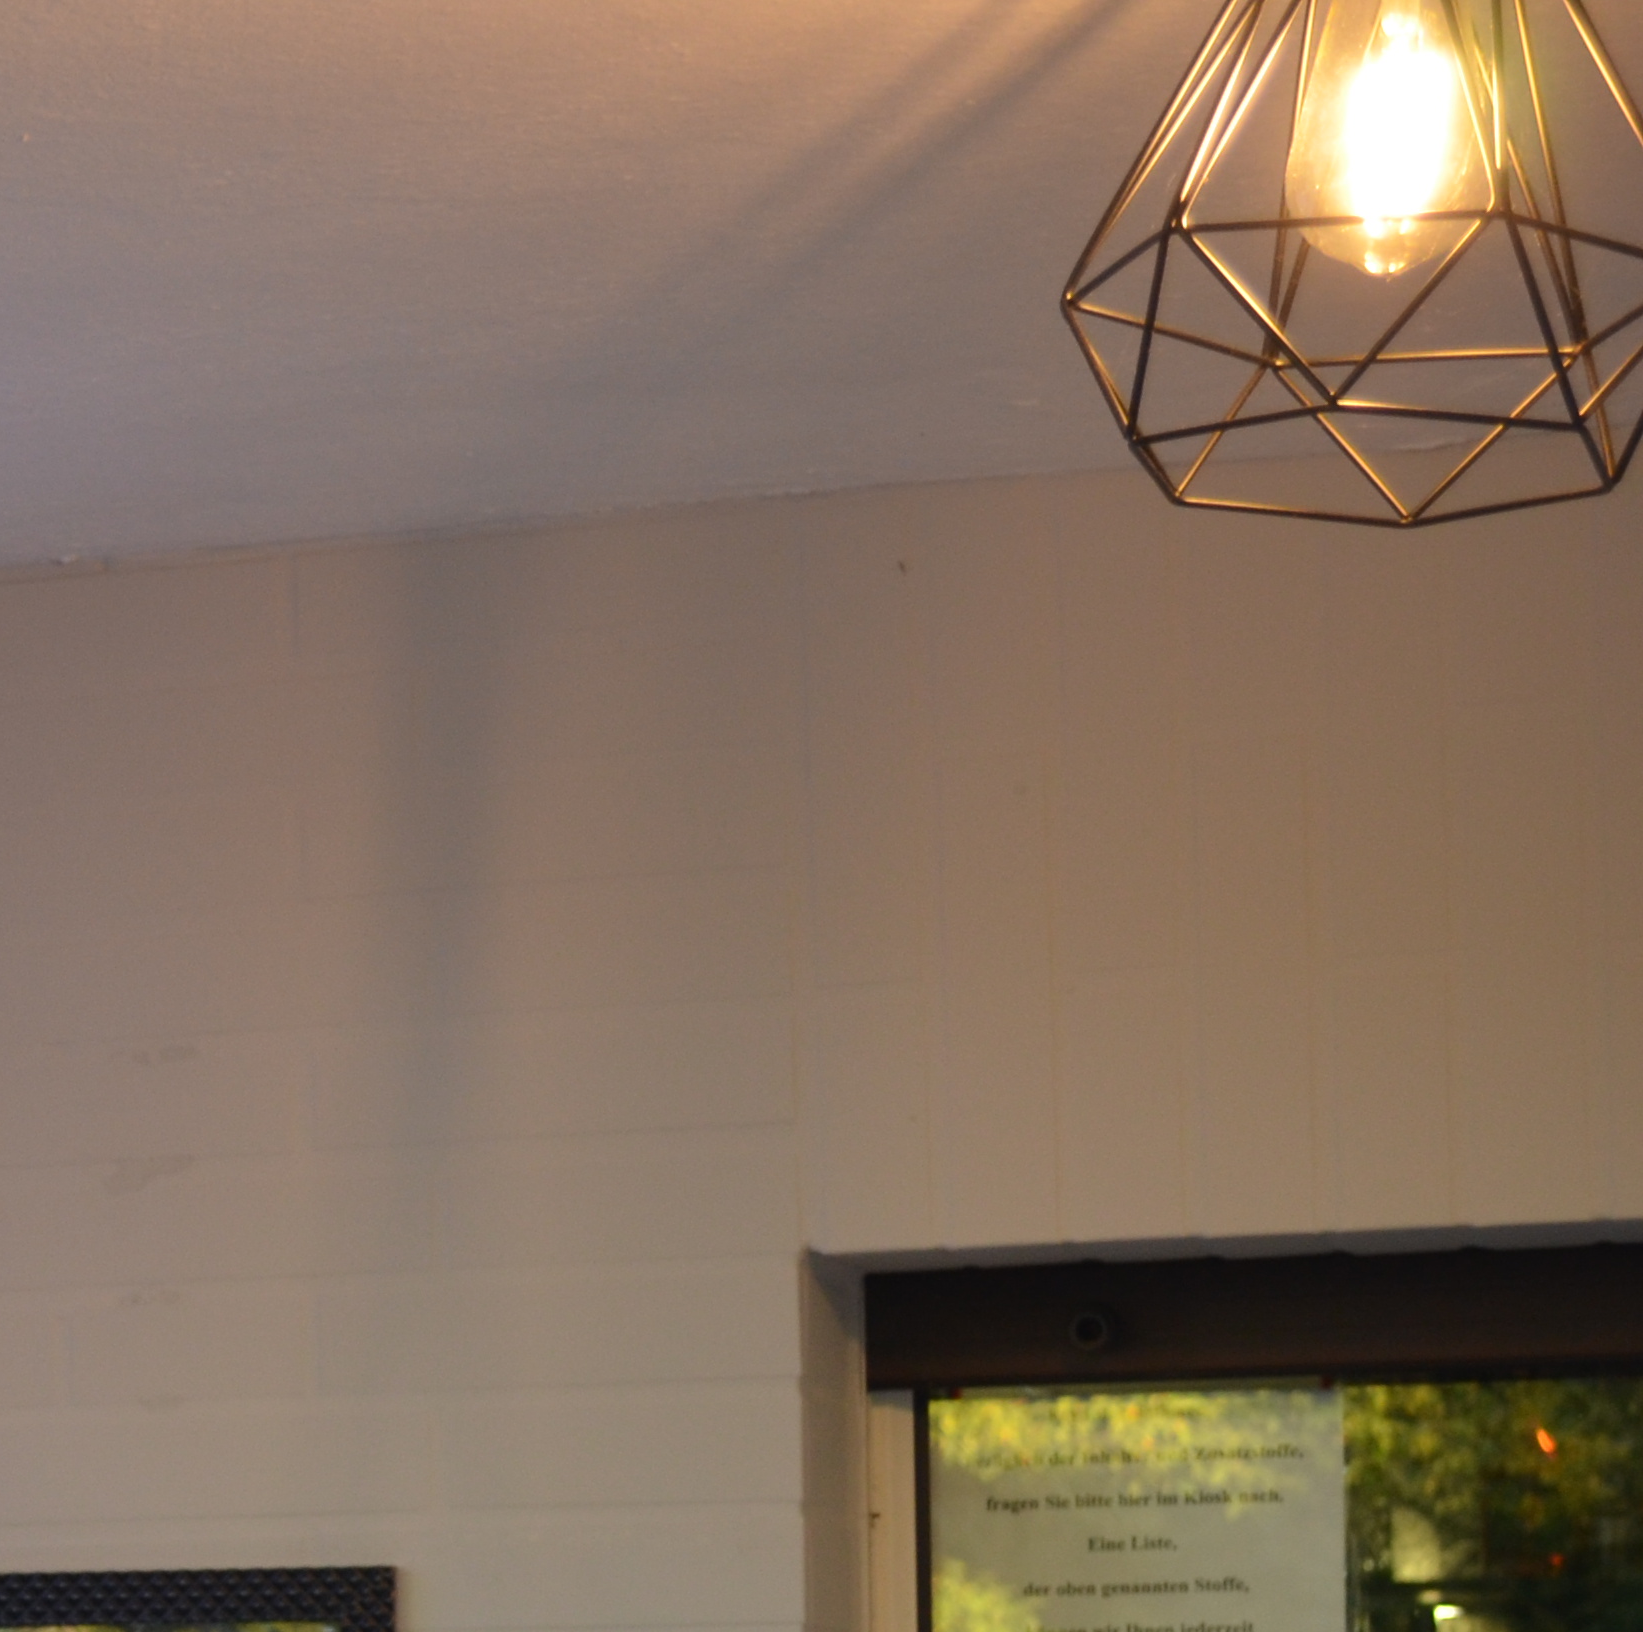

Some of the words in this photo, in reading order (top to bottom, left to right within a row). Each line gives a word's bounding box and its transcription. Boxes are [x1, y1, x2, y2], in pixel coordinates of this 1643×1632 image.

[985, 1496, 1040, 1514] fragen
[1045, 1495, 1071, 1510] Sie
[1075, 1493, 1114, 1509] bitte
[1118, 1492, 1153, 1508] hier
[1156, 1491, 1179, 1507] im
[1183, 1489, 1233, 1506] Kiosk
[1087, 1537, 1126, 1553] Eine
[1023, 1581, 1050, 1597] der
[1056, 1580, 1096, 1597] oben
[1101, 1580, 1190, 1599] genannten
